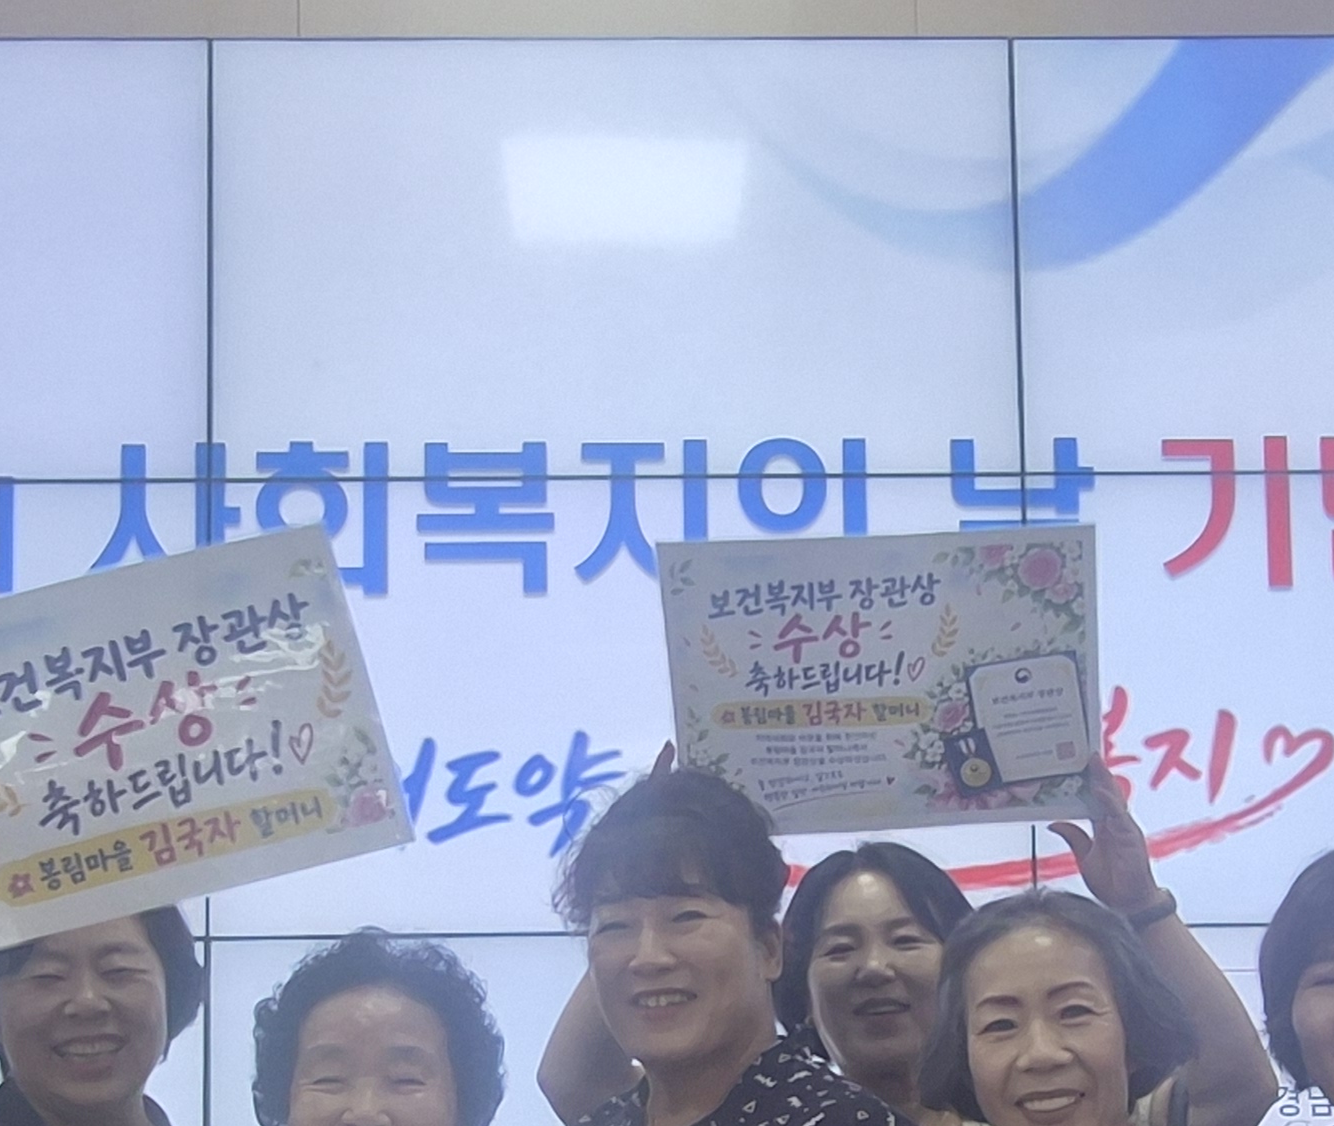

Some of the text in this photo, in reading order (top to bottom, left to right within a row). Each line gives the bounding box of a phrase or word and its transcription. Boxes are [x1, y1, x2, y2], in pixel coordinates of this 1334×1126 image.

[708, 573, 942, 620] 보건복지부 장관상
[172, 593, 310, 666] 장관상
[773, 612, 872, 664] 수상
[745, 651, 905, 698] 축하드립니다!
[74, 670, 216, 770] 수상
[803, 700, 867, 727] 김국자
[871, 702, 920, 722] 할머니
[39, 720, 284, 837] 축하드립니다!
[39, 795, 323, 891] 봉림마을 김국자 할머니
